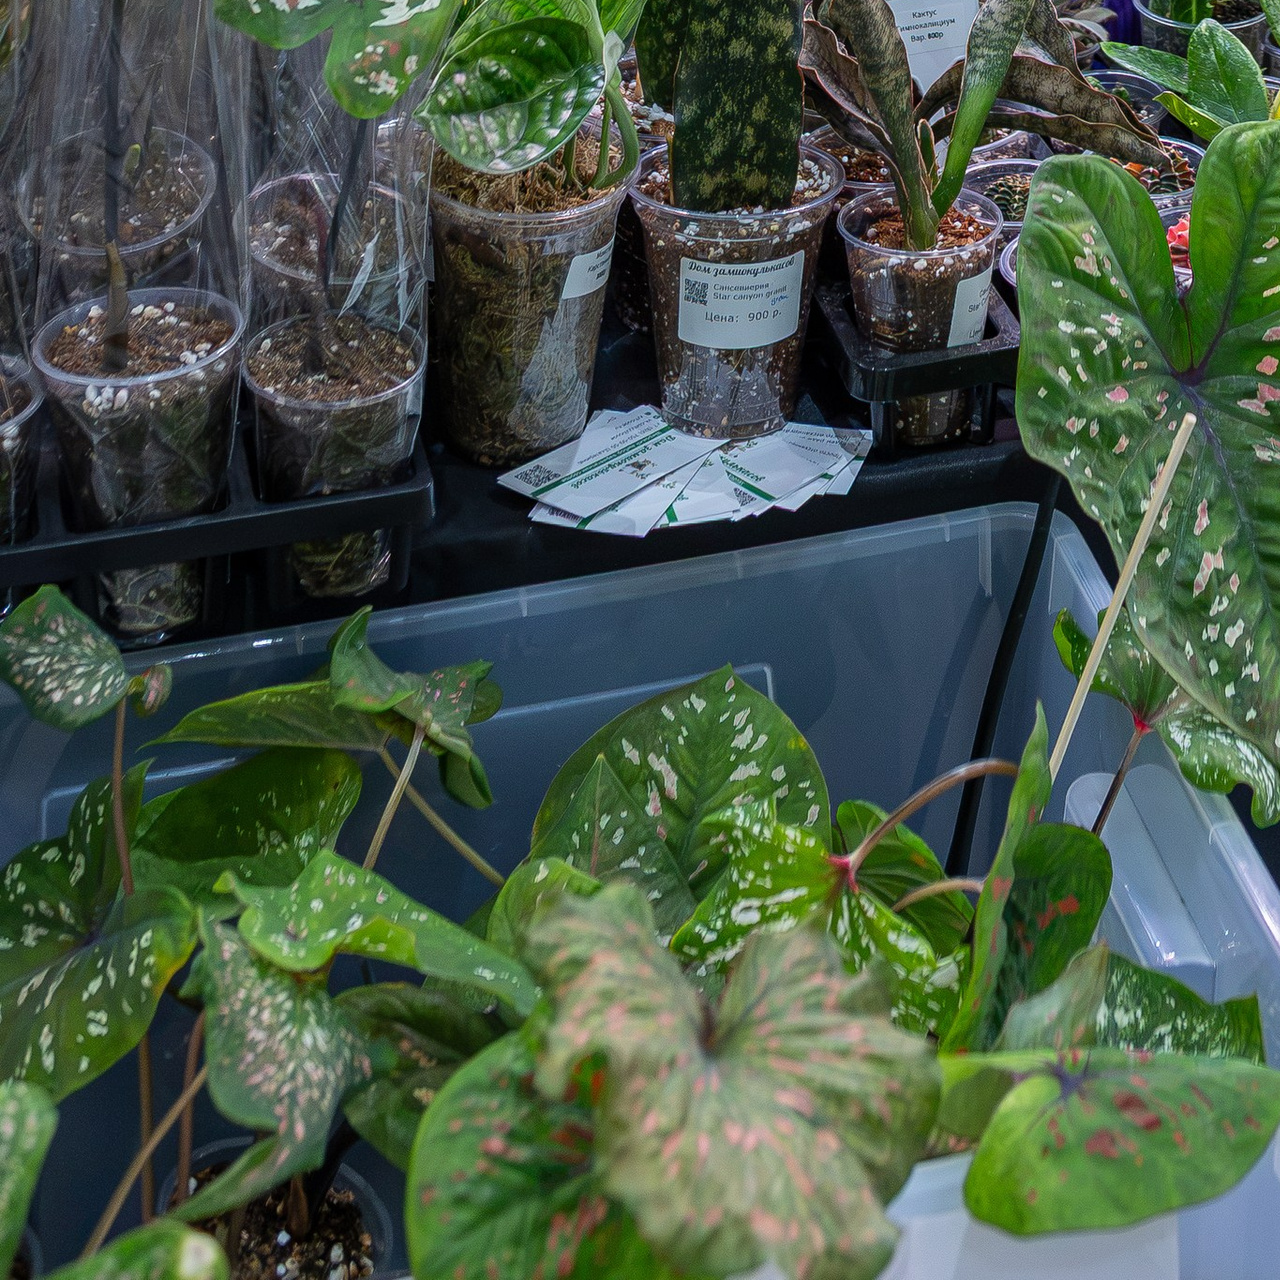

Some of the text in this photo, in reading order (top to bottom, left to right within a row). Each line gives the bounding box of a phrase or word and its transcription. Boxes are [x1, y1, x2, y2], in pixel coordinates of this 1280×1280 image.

[912, 9, 937, 19] Кактус
[688, 256, 795, 278] Дом замиокулькасов
[713, 282, 770, 291] Сансевиерия
[713, 292, 730, 301] Star
[733, 291, 764, 301] canyon
[704, 308, 782, 323] Цена: 900 р.
